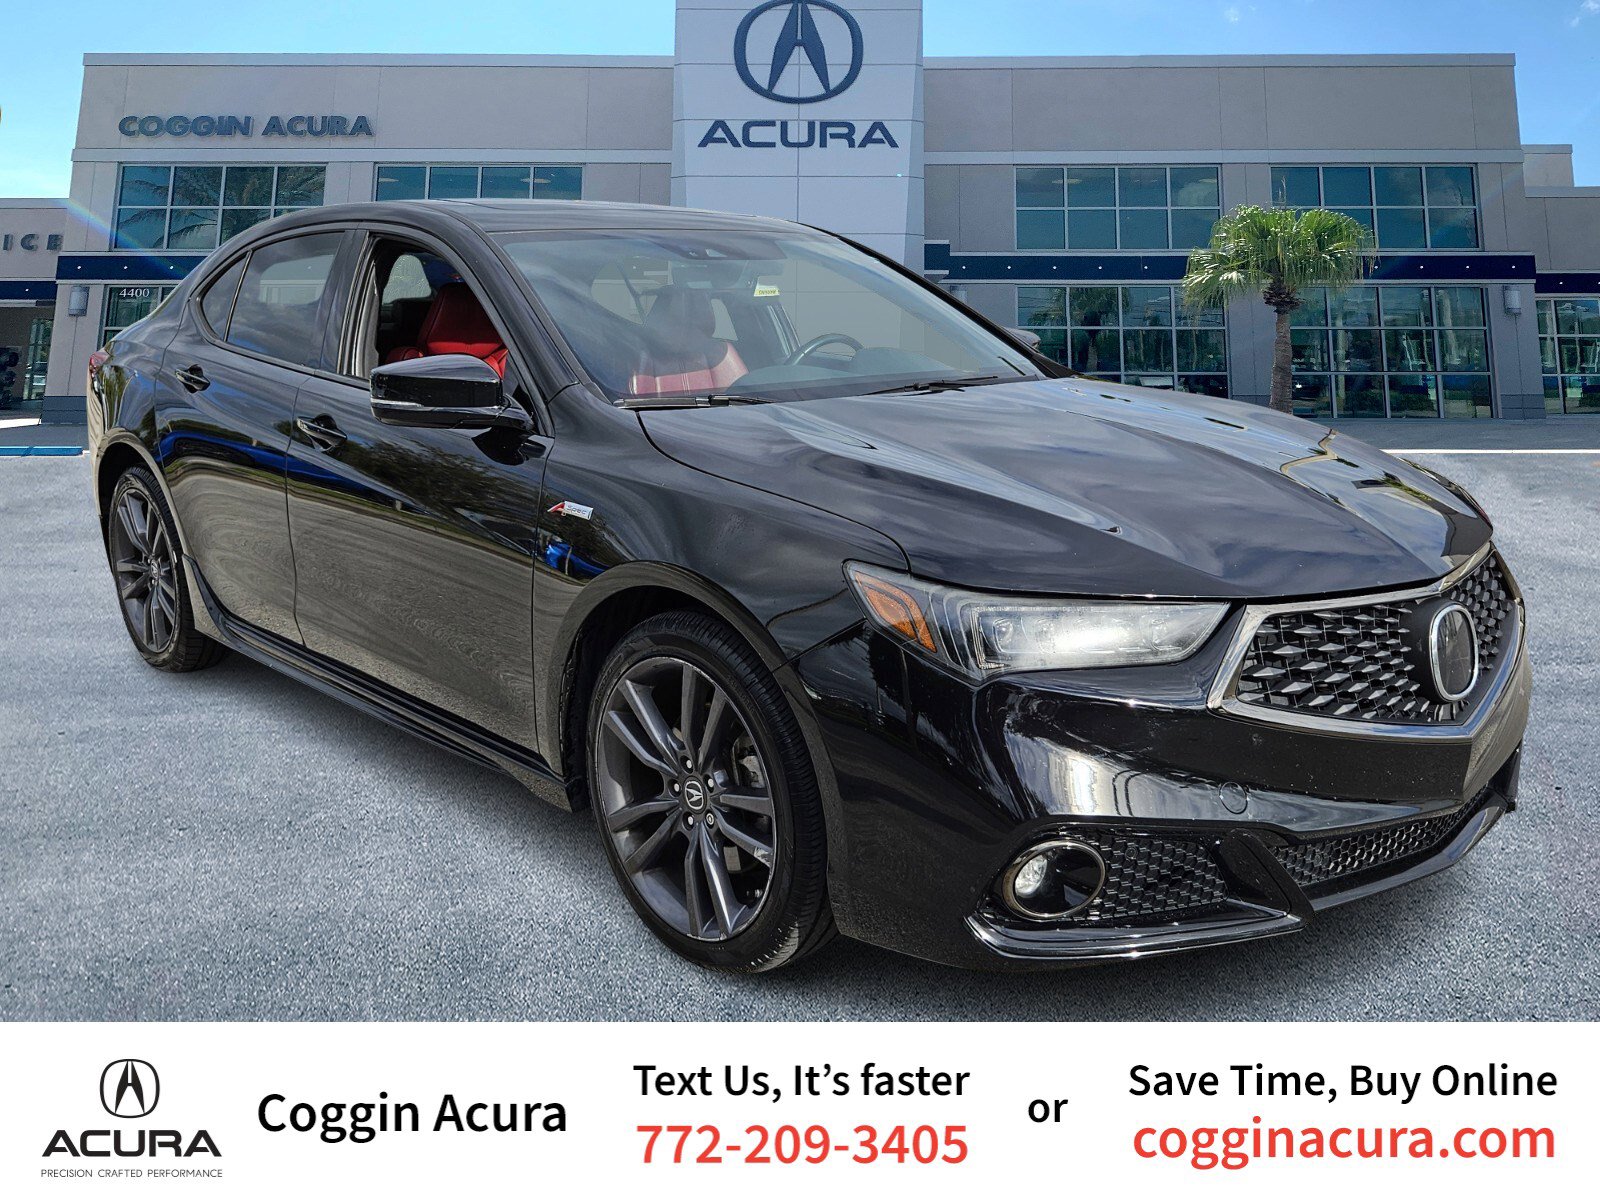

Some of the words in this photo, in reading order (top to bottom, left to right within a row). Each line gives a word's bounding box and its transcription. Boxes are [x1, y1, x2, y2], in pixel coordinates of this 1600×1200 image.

[118, 115, 252, 137] COGGIN
[262, 115, 374, 137] ACURA
[697, 119, 899, 149] ACURA
[2, 233, 63, 251] ICE
[119, 288, 149, 298] 4400
